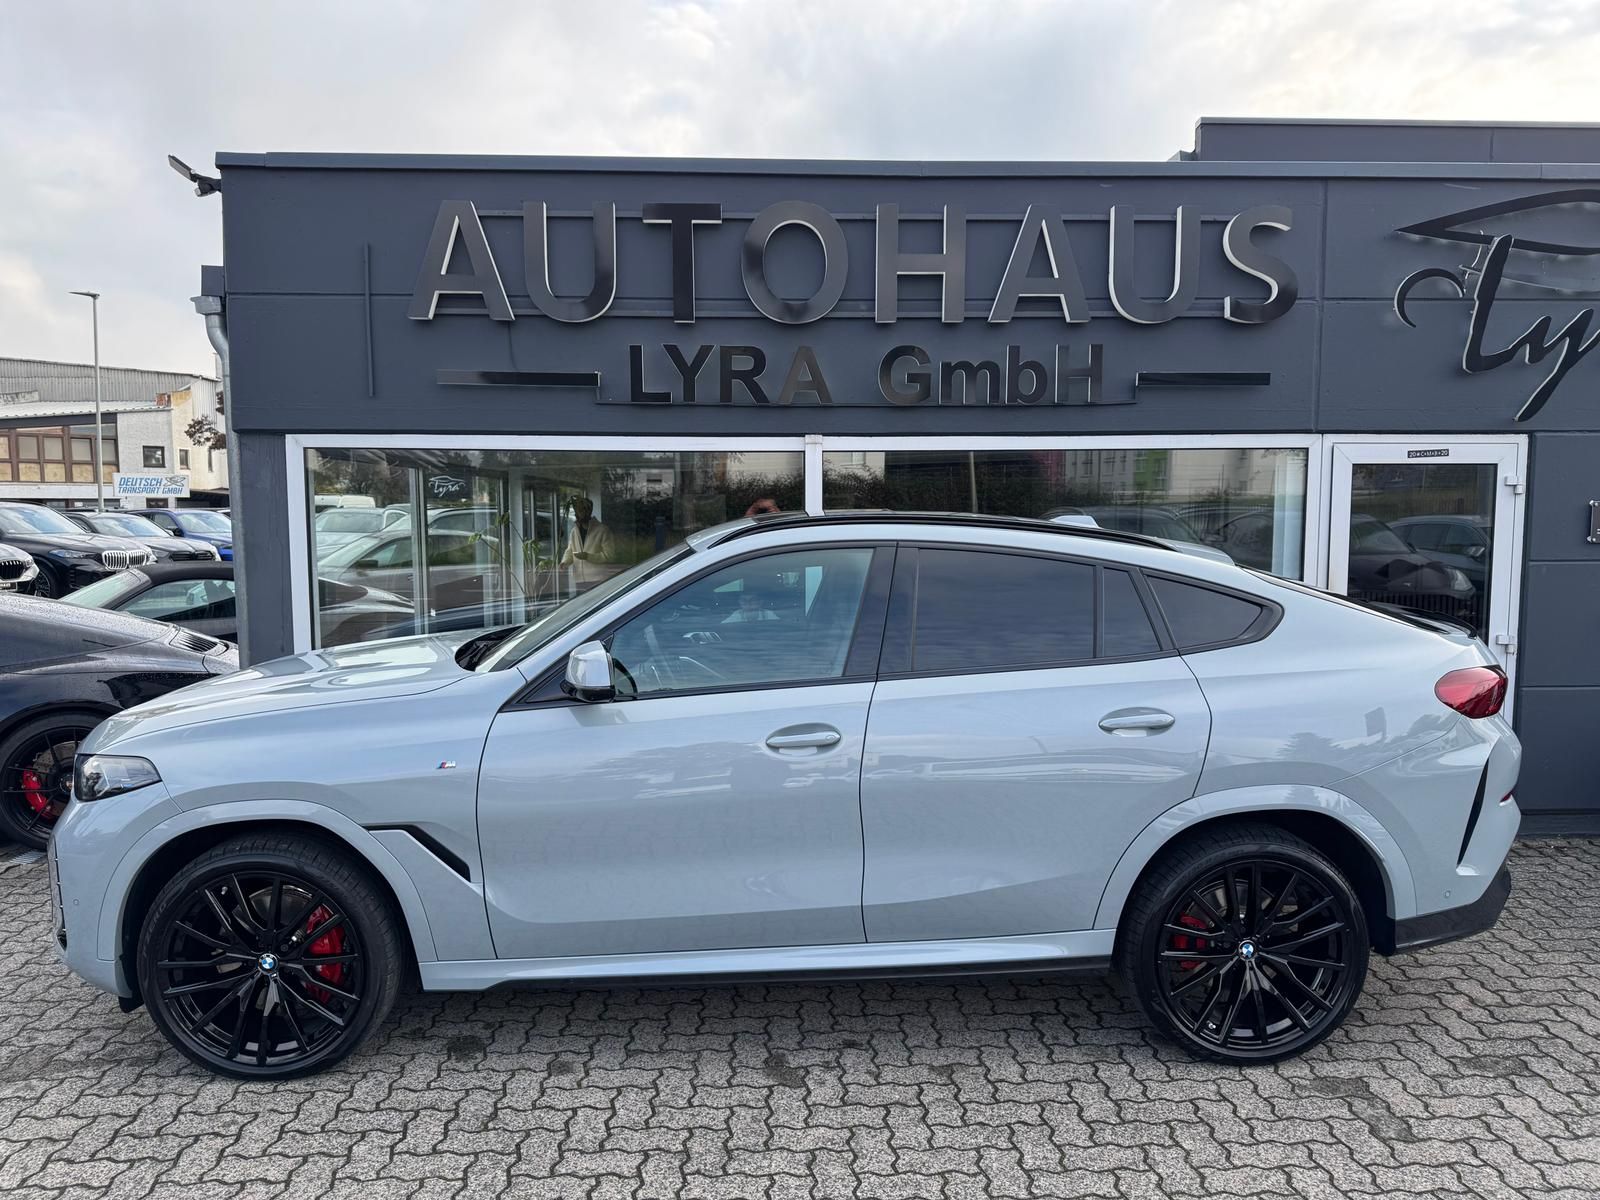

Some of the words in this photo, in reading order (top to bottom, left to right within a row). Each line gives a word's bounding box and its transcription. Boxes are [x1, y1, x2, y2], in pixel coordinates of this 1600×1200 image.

[407, 200, 1299, 325] AUTOHAUS
[628, 343, 833, 405] LYRA
[878, 343, 1103, 406] GmbH
[118, 477, 163, 487] DEUTSCH
